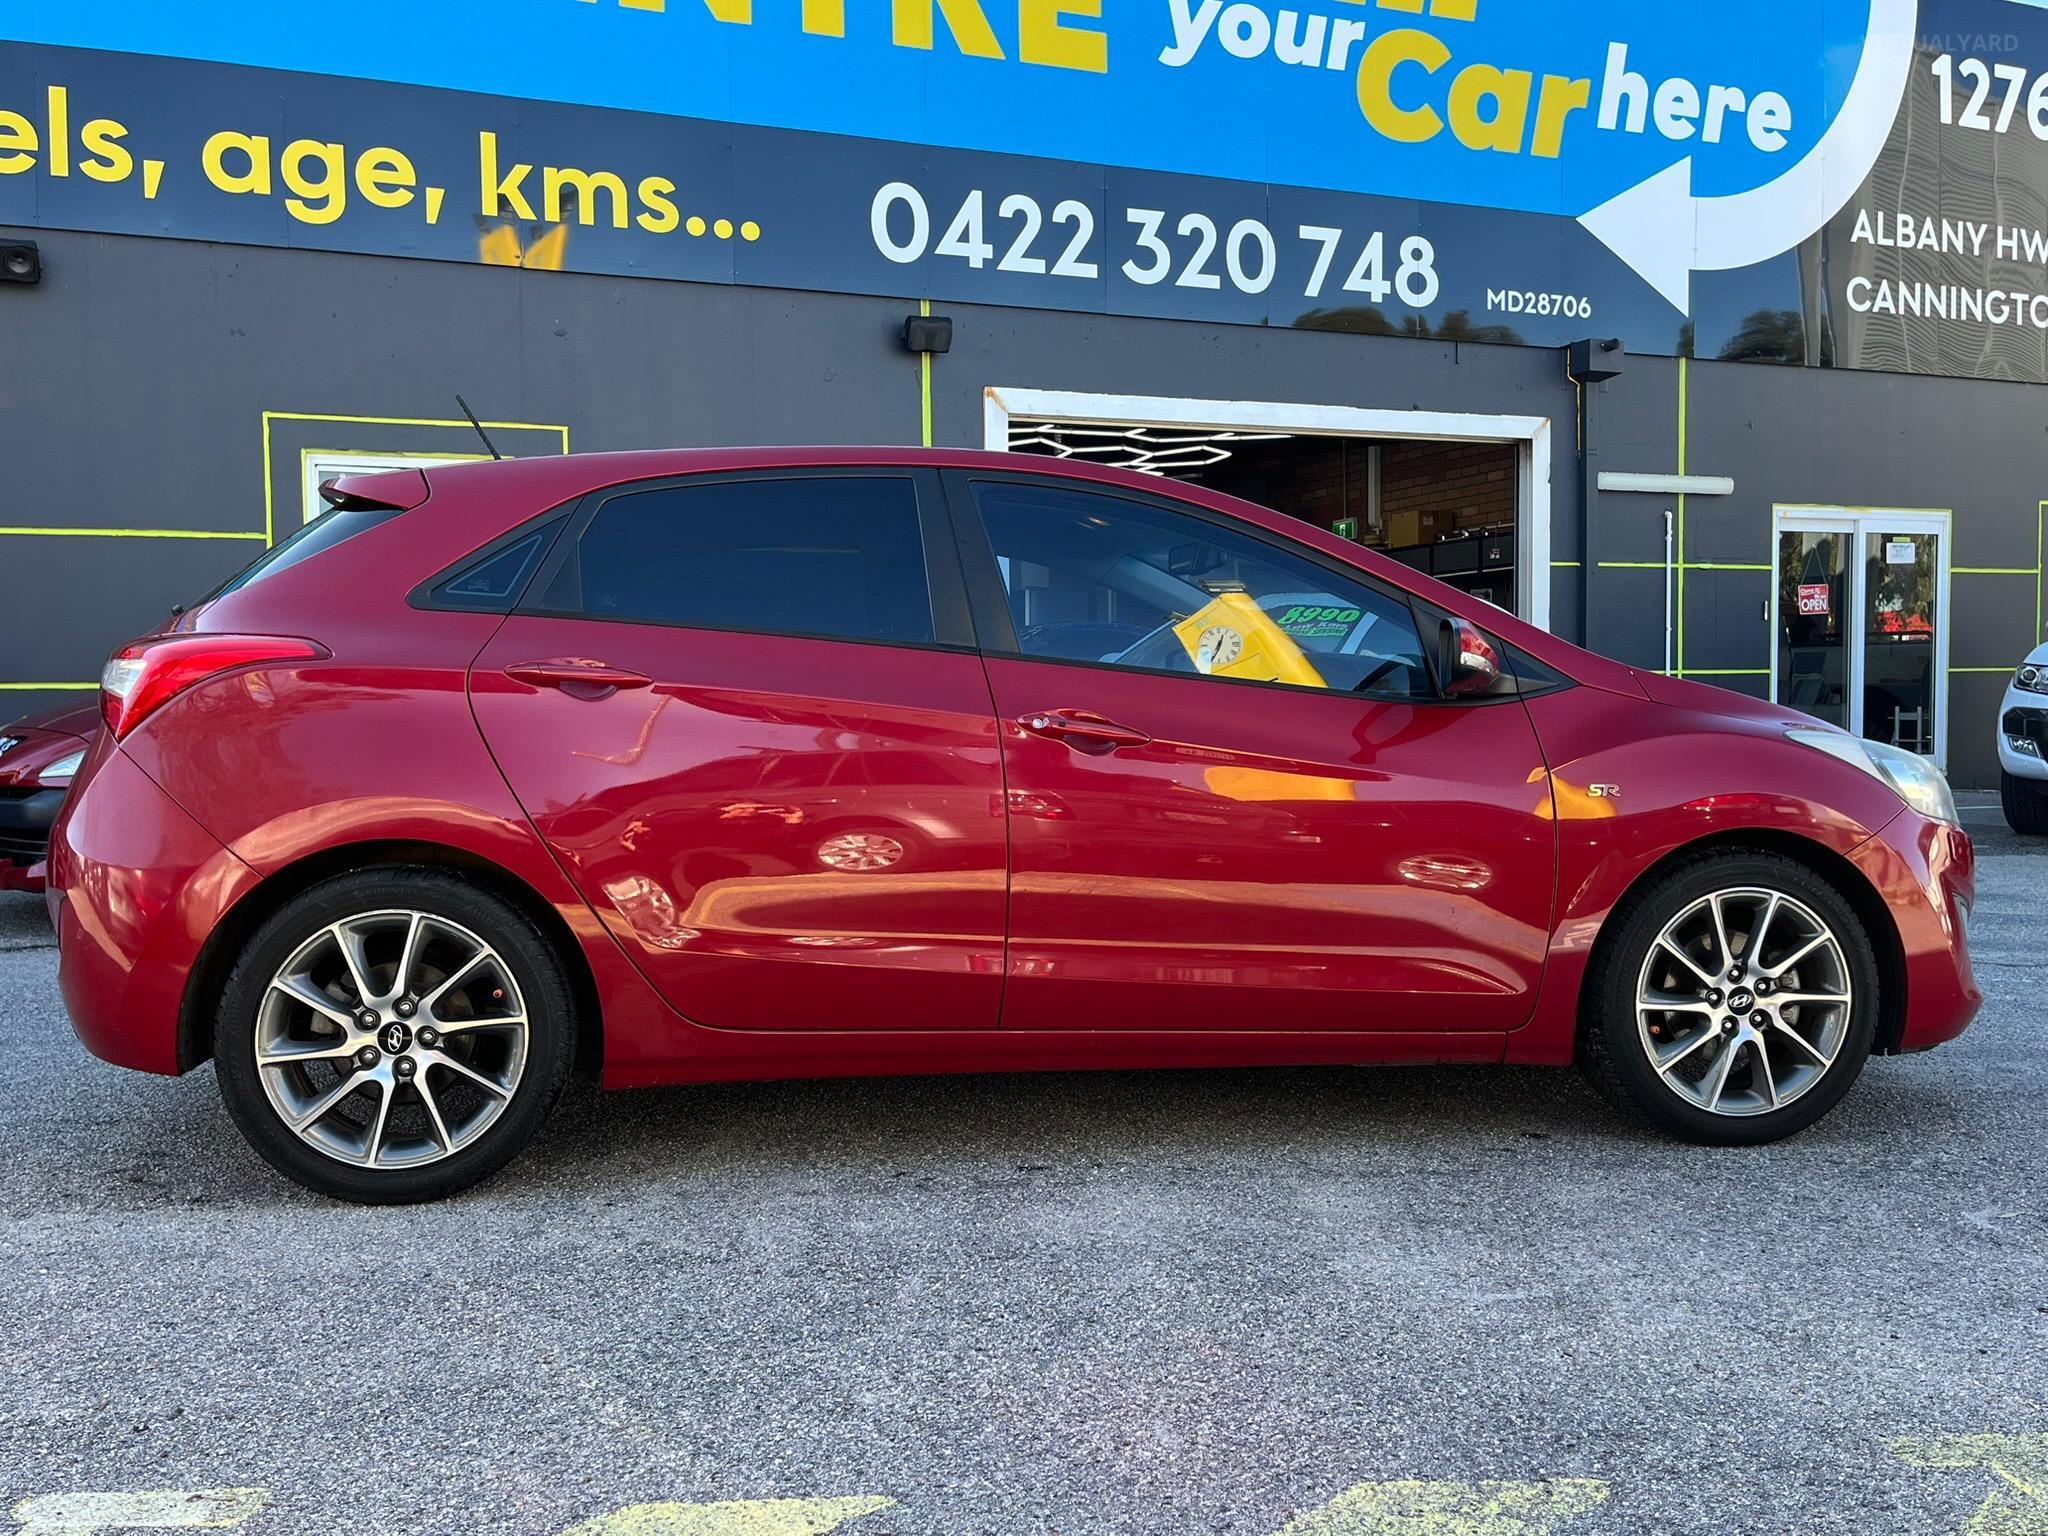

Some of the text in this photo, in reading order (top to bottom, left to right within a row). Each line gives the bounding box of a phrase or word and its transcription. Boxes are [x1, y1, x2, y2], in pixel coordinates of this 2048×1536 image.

[1158, 0, 1366, 77] your
[1357, 29, 1590, 158] Car
[1597, 41, 1792, 152] here
[1930, 53, 2048, 142] 1276
[203, 132, 443, 224] age,
[480, 132, 762, 241] kms...
[869, 181, 1440, 309] 0422 320 748
[1849, 207, 1988, 257] ALBANY
[1486, 287, 1593, 320] MD28706
[1277, 606, 1361, 624] 8990
[1801, 598, 1827, 611] OPEN
[1587, 783, 1621, 797] SR
